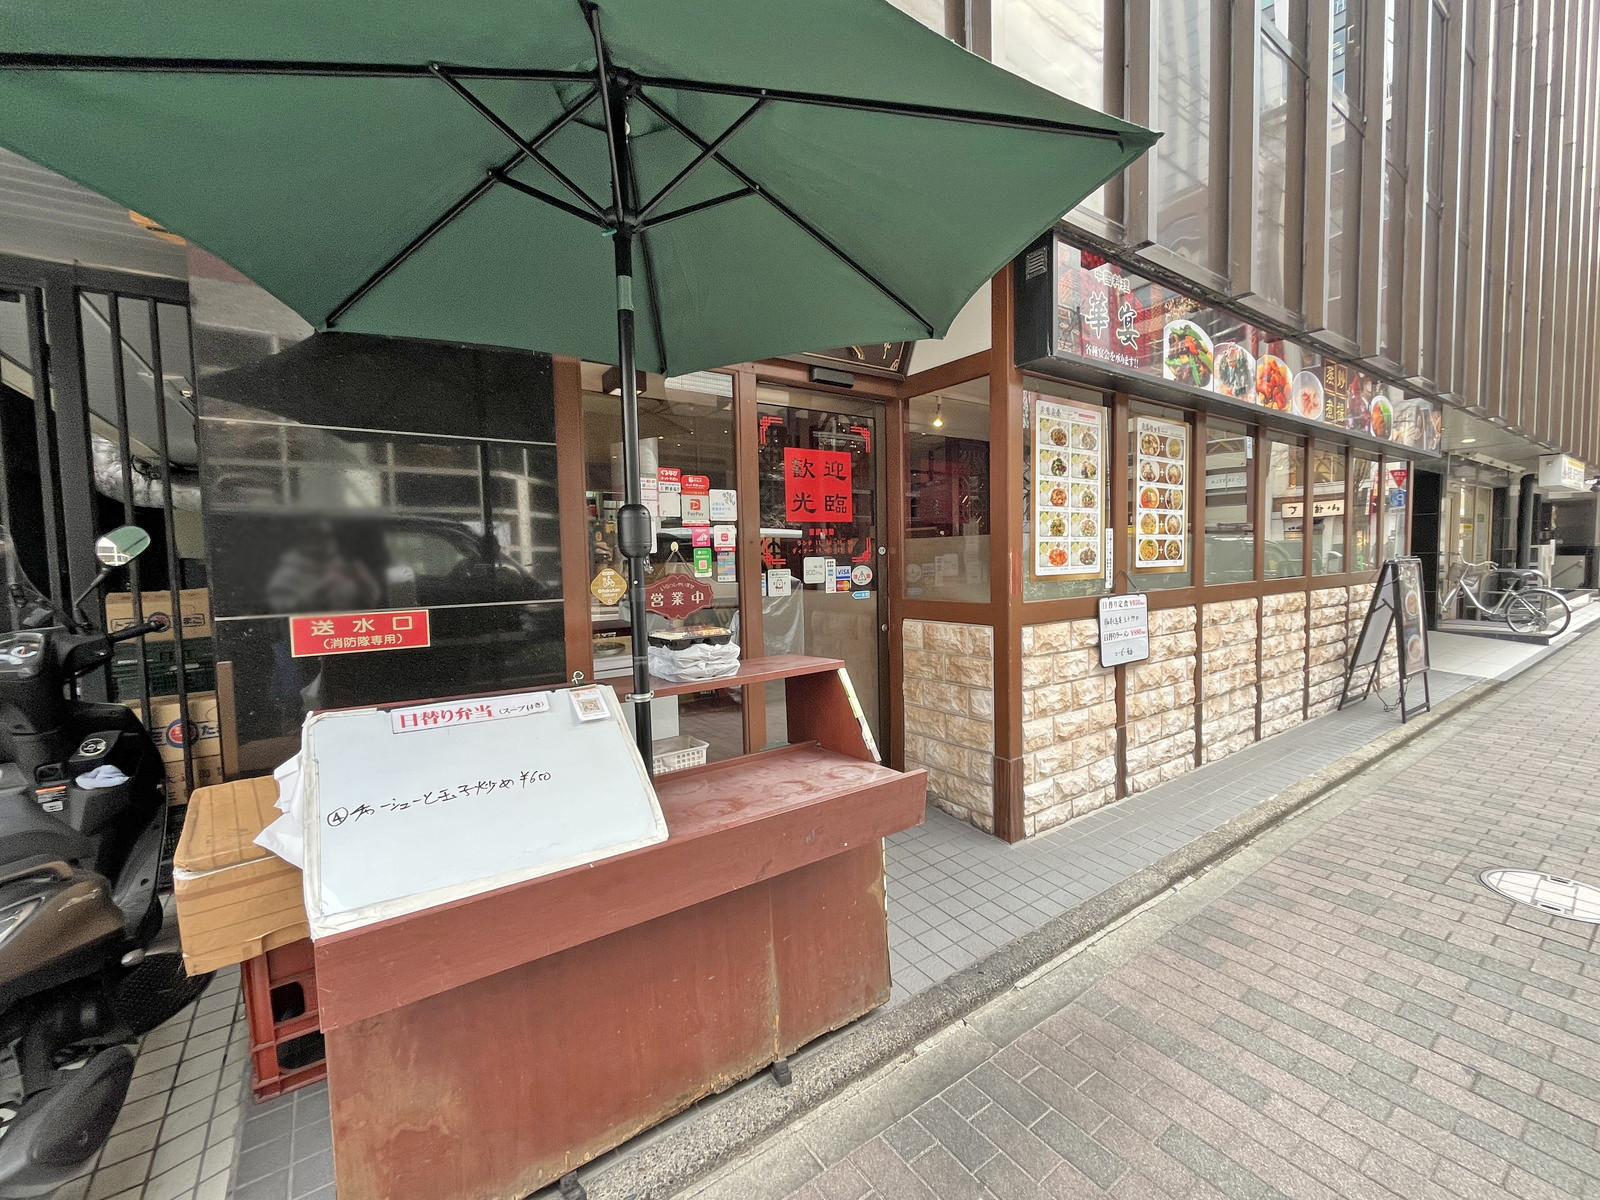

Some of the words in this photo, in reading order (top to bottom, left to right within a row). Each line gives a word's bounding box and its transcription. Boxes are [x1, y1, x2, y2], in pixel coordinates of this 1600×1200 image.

[1094, 269, 1130, 294] 中国料理
[1085, 291, 1140, 350] 華宴
[791, 491, 848, 514] 光臨
[650, 590, 704, 607] 営業中
[310, 615, 413, 637] 送水口
[323, 633, 403, 650] (消防隊専用)
[400, 704, 493, 729] 日替り弁当
